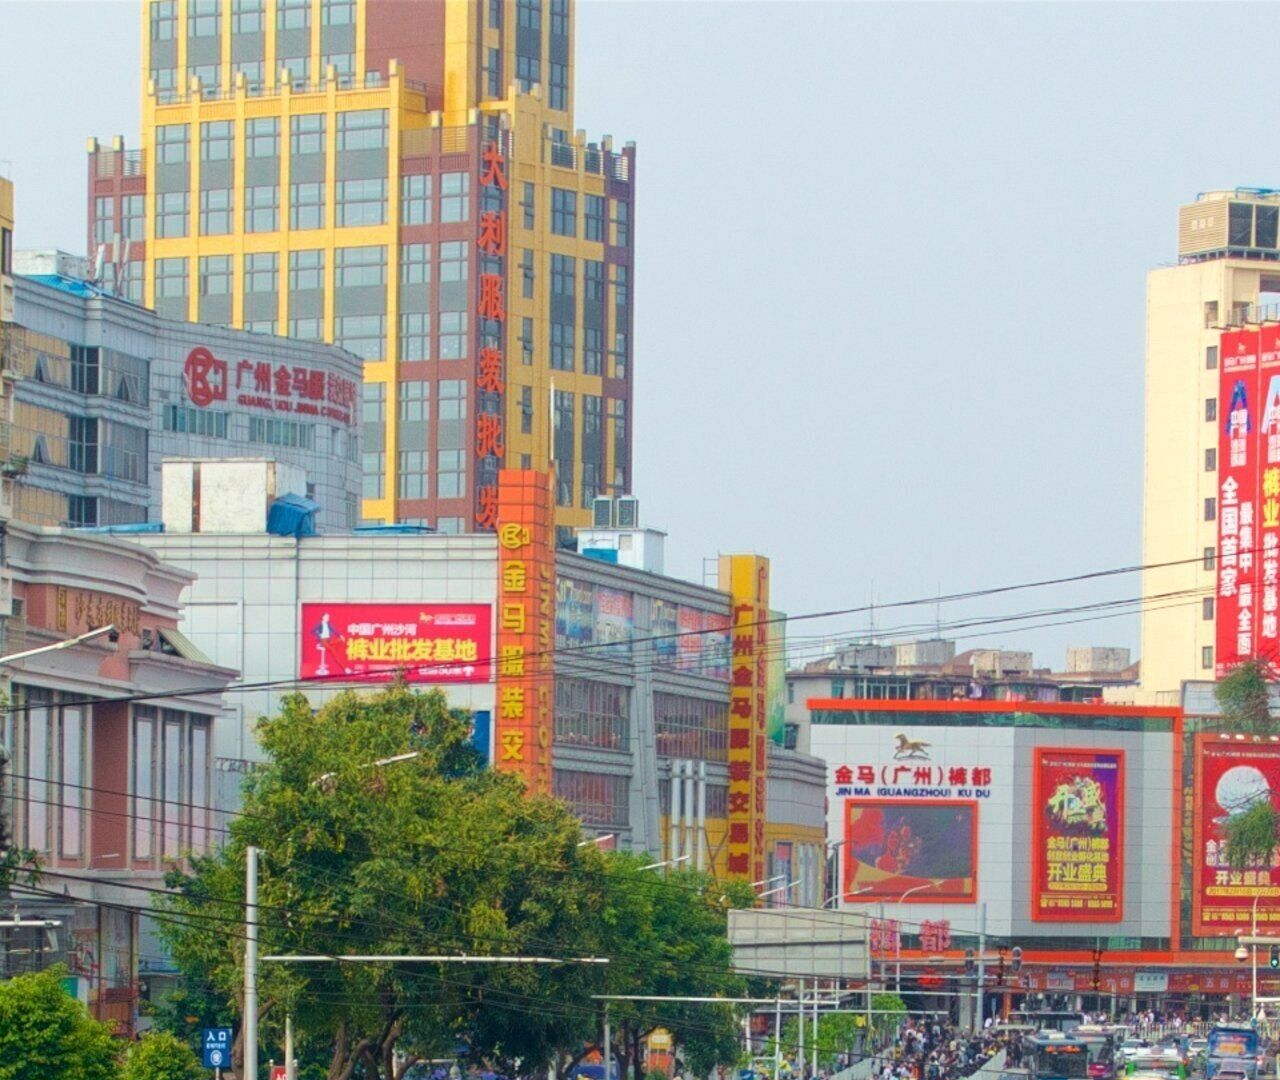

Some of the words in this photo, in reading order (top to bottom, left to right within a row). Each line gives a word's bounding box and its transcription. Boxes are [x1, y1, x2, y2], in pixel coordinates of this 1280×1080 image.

[1221, 475, 1238, 596] 全国首家
[346, 638, 477, 661] 裤业批发基地
[836, 788, 852, 796] JIN
[854, 788, 871, 796] MA
[958, 789, 972, 797] KU
[976, 789, 991, 798] DU
[1048, 863, 1107, 883] 开业盛典
[206, 1031, 226, 1042] 入口
